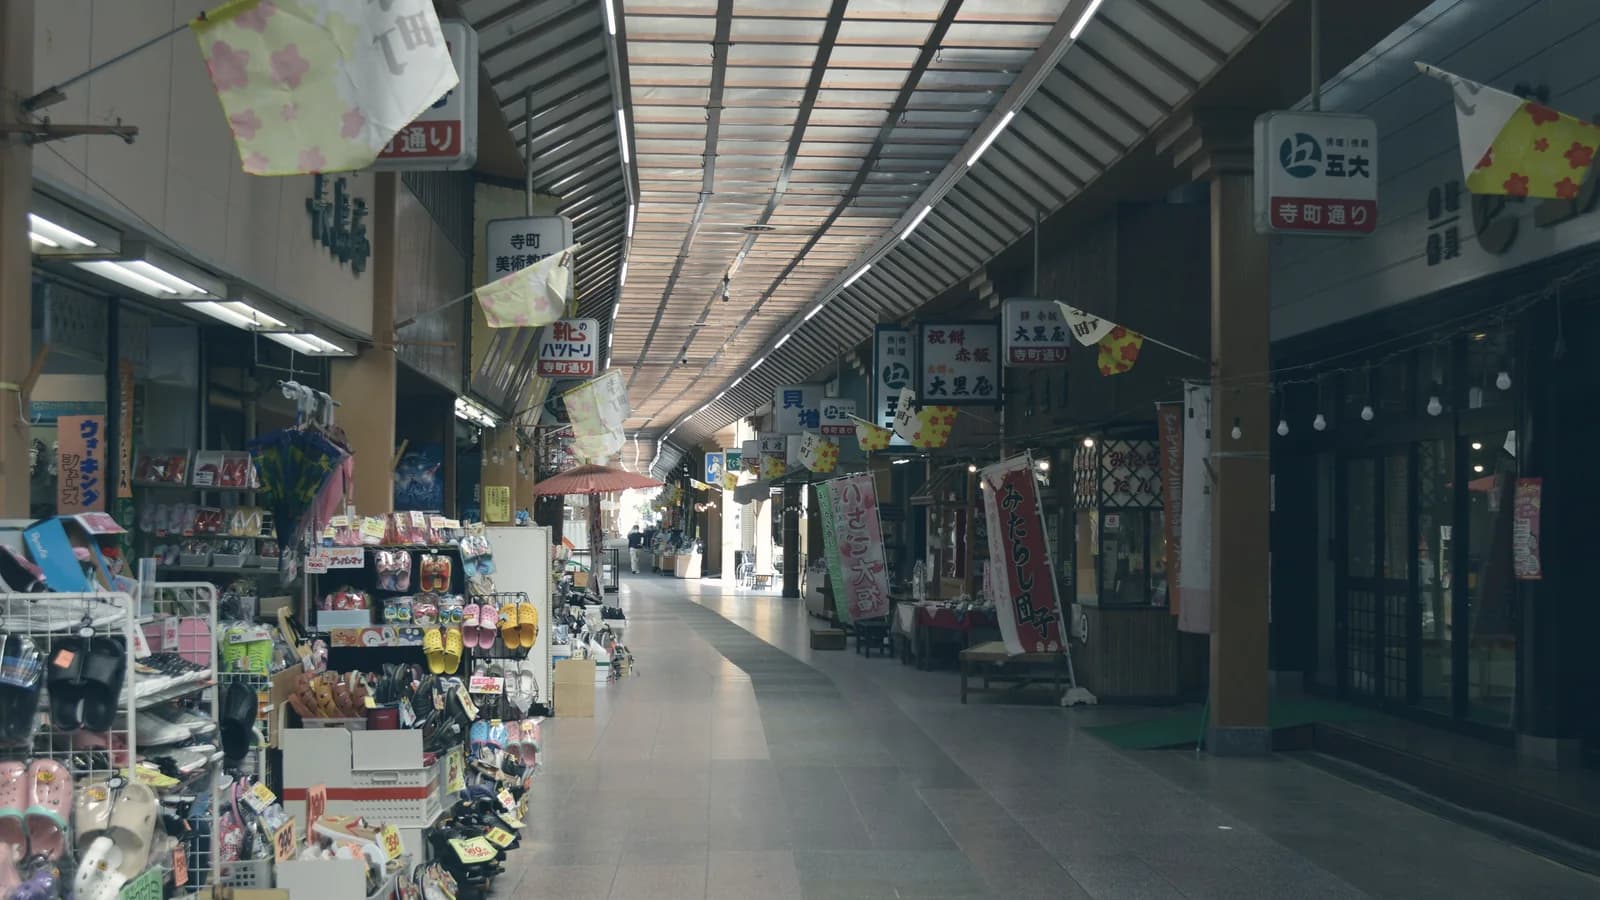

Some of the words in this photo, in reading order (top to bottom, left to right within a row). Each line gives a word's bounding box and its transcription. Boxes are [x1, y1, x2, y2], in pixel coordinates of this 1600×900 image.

[383, 125, 453, 154] 通り
[1325, 154, 1370, 178] 五大
[1279, 203, 1368, 226] 寺町通り
[510, 233, 541, 250] 寺町
[496, 252, 556, 273] 美術教
[1013, 323, 1065, 341] 大黒屋
[1013, 345, 1066, 359] 寺町通り
[543, 361, 592, 375] 寺町通り
[928, 375, 994, 397] 大黒屋
[79, 419, 99, 507] ウォーキング
[1000, 482, 1055, 641] みたらし団子
